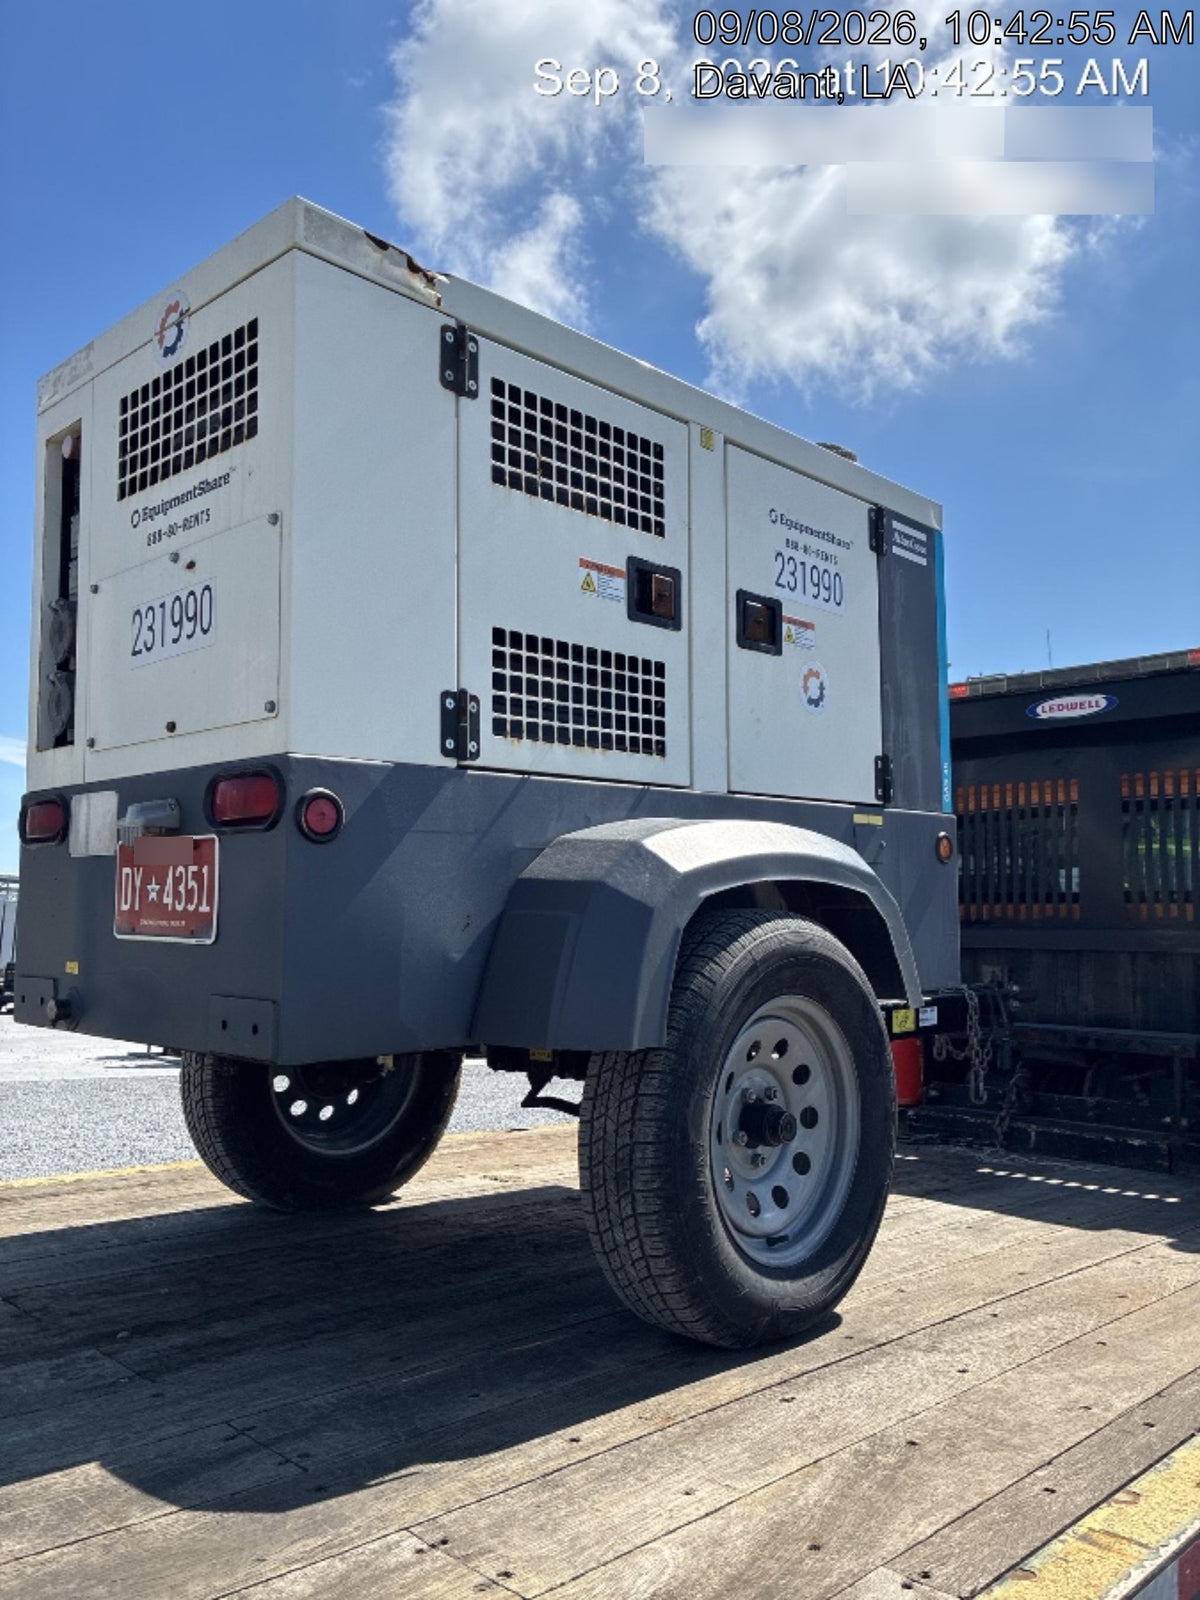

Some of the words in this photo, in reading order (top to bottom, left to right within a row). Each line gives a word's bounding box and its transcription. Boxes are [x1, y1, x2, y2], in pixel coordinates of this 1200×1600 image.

[142, 472, 231, 523] EquipmentShare
[774, 551, 844, 607] 231990
[131, 584, 213, 656] 231990
[1041, 698, 1102, 714] LEDWELL
[120, 867, 143, 911] DY
[163, 865, 211, 912] 4351
